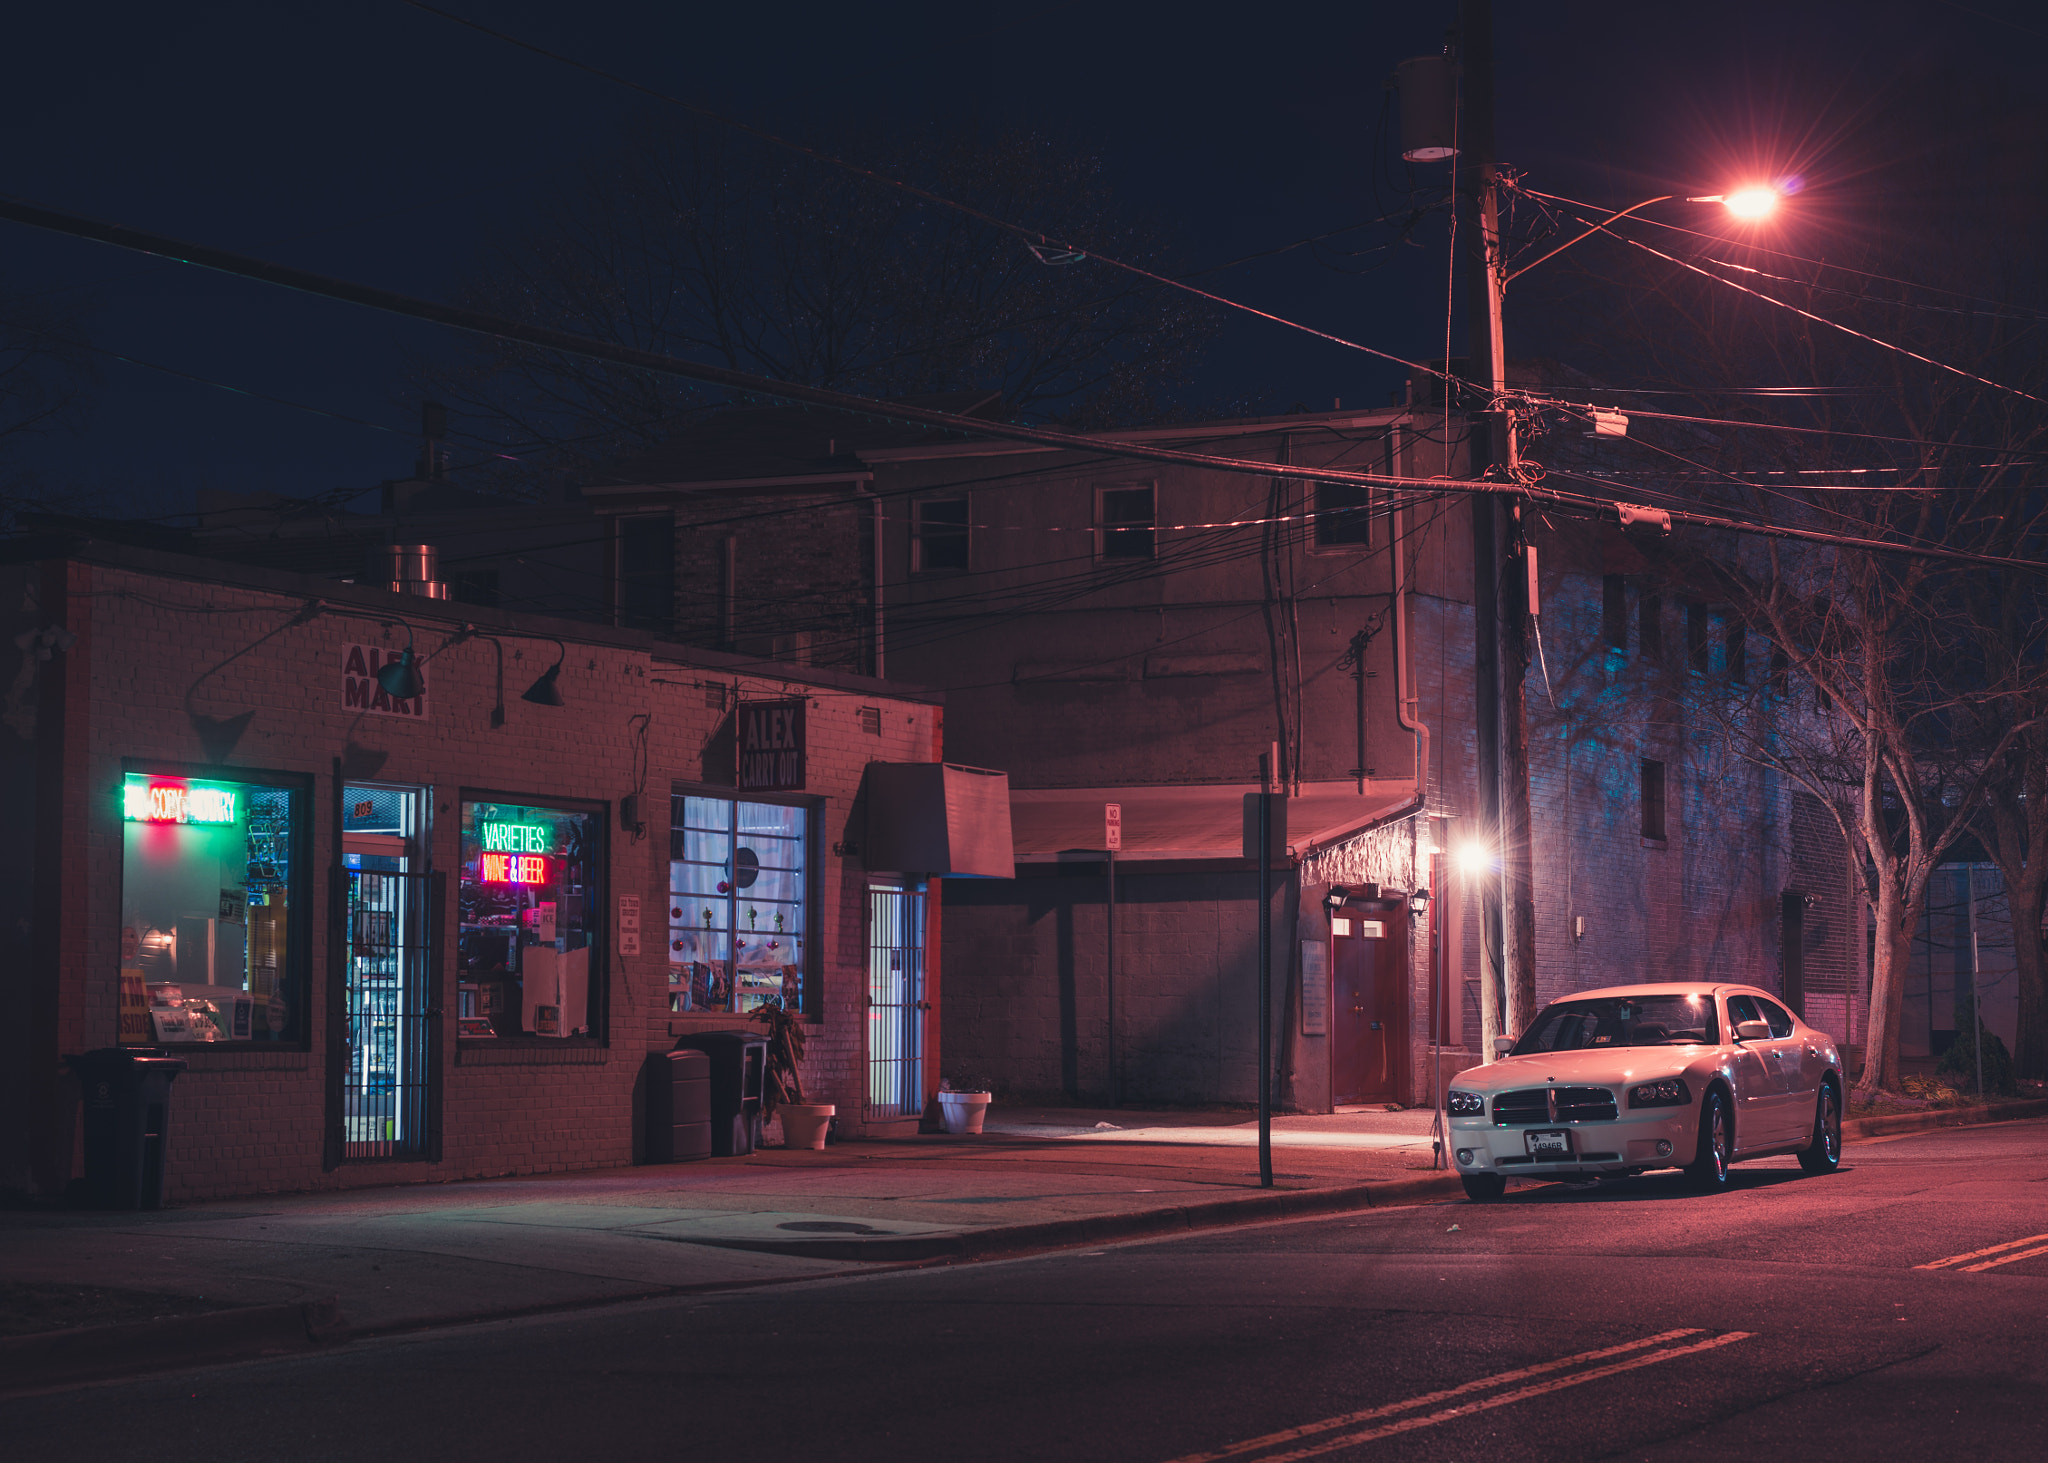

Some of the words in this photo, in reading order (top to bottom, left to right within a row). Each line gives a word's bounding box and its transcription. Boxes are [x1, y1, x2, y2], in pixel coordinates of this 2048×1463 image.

[746, 709, 796, 753] ALEX
[742, 750, 776, 792] CARRY
[779, 750, 799, 790] OUT
[355, 801, 373, 817] 809
[1109, 809, 1117, 818] NO
[483, 822, 544, 853] VARIETIES
[483, 854, 509, 882] WINE
[510, 855, 518, 882] &
[518, 856, 544, 884] BEER
[542, 914, 554, 923] ICE
